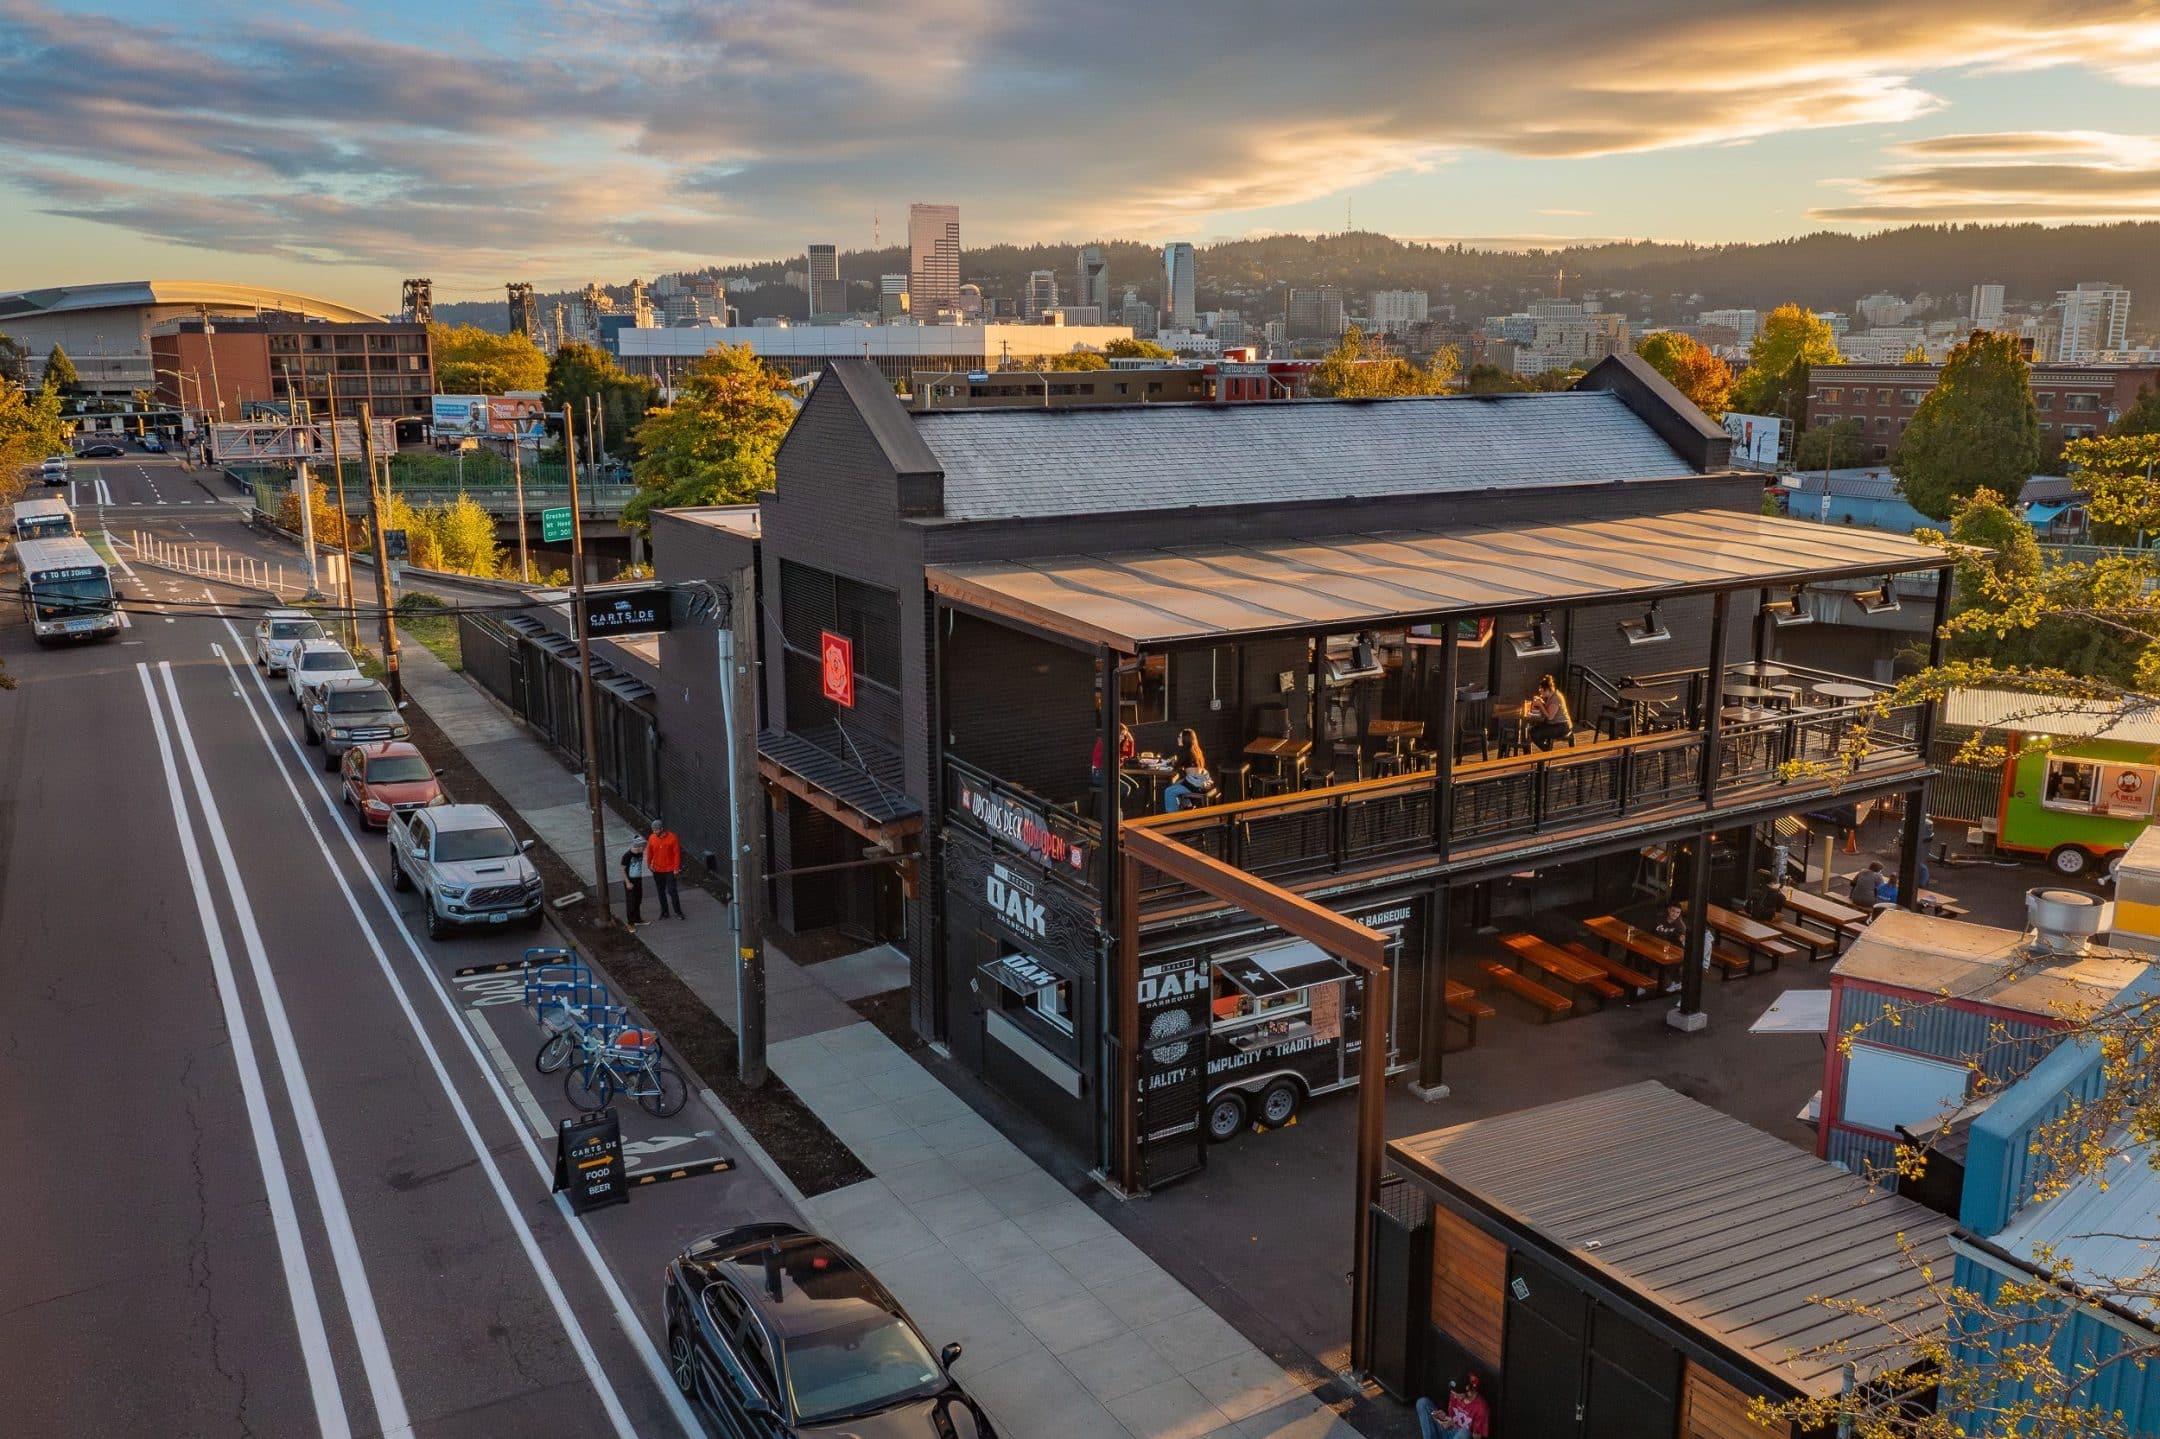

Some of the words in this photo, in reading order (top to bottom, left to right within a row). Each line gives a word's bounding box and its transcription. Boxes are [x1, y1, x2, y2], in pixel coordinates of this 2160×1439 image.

[545, 512, 571, 520] Gresham
[41, 572, 47, 580] 4
[71, 569, 92, 577] JOHNS
[590, 610, 654, 622] CARTSIDE
[972, 792, 1002, 829] UPSTAIRS
[1003, 810, 1023, 841] DECK
[1023, 818, 1041, 848] NOW
[1040, 831, 1066, 862] OPEN!
[986, 875, 1046, 937] OAK
[1365, 907, 1411, 927] BARBEQUE
[1002, 955, 1057, 986] OAK
[1137, 969, 1209, 1004] OAK
[1146, 993, 1196, 1009] BARBEQUE
[1207, 1049, 1262, 1075] IMPLICITY
[585, 1168, 610, 1180] FOOD
[588, 1183, 611, 1195] BEER
